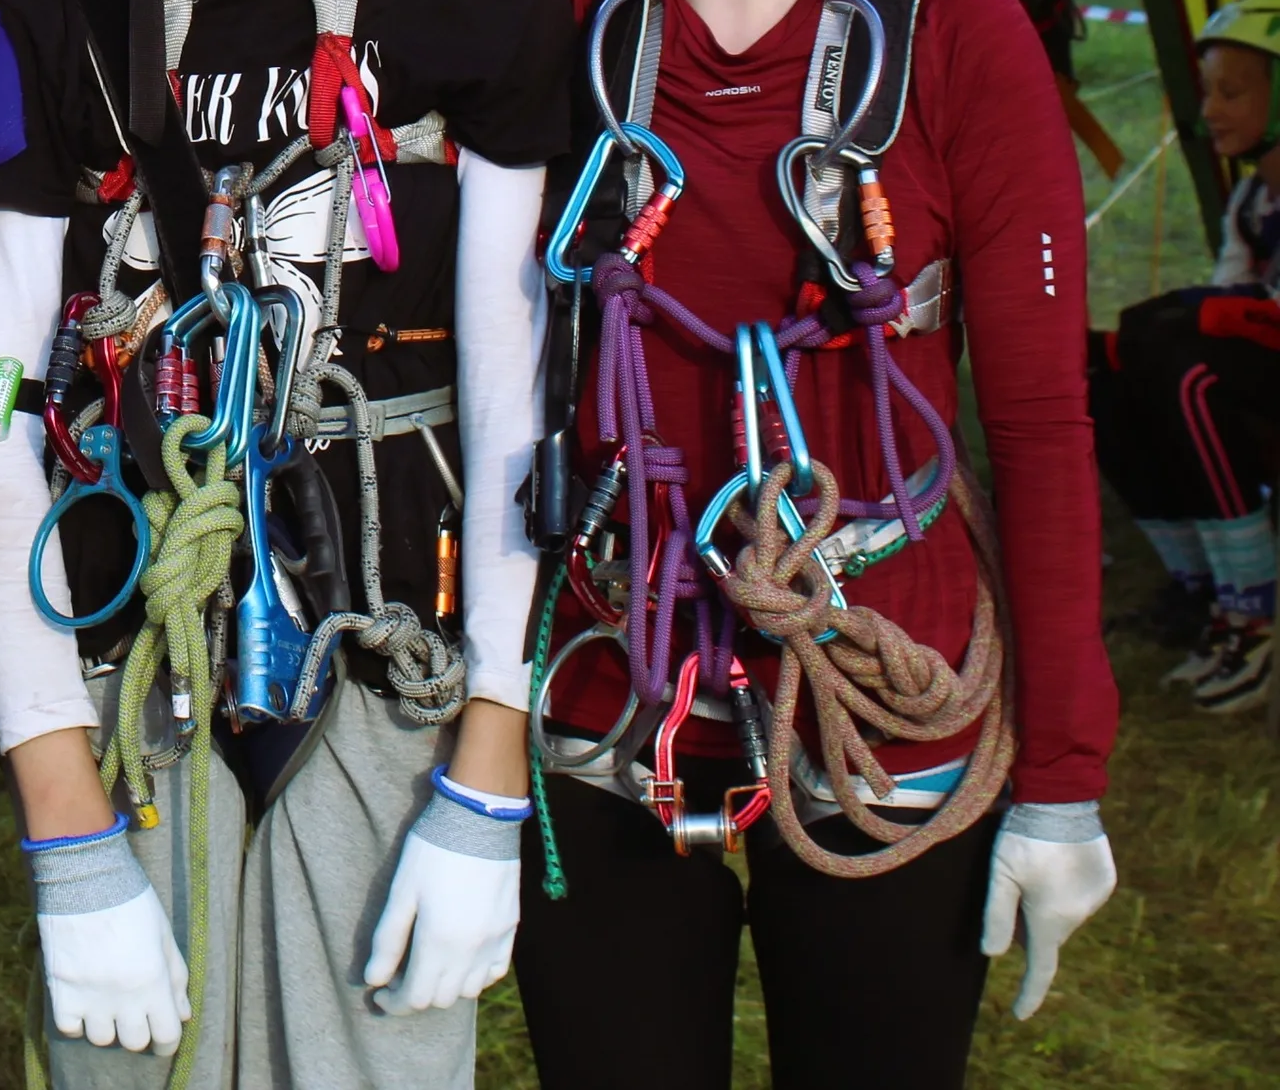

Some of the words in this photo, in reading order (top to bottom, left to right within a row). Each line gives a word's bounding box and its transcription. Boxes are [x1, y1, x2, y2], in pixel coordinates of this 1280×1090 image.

[705, 85, 761, 97] NORDSKI
[822, 51, 842, 100] VENTO
[182, 72, 242, 146] ER
